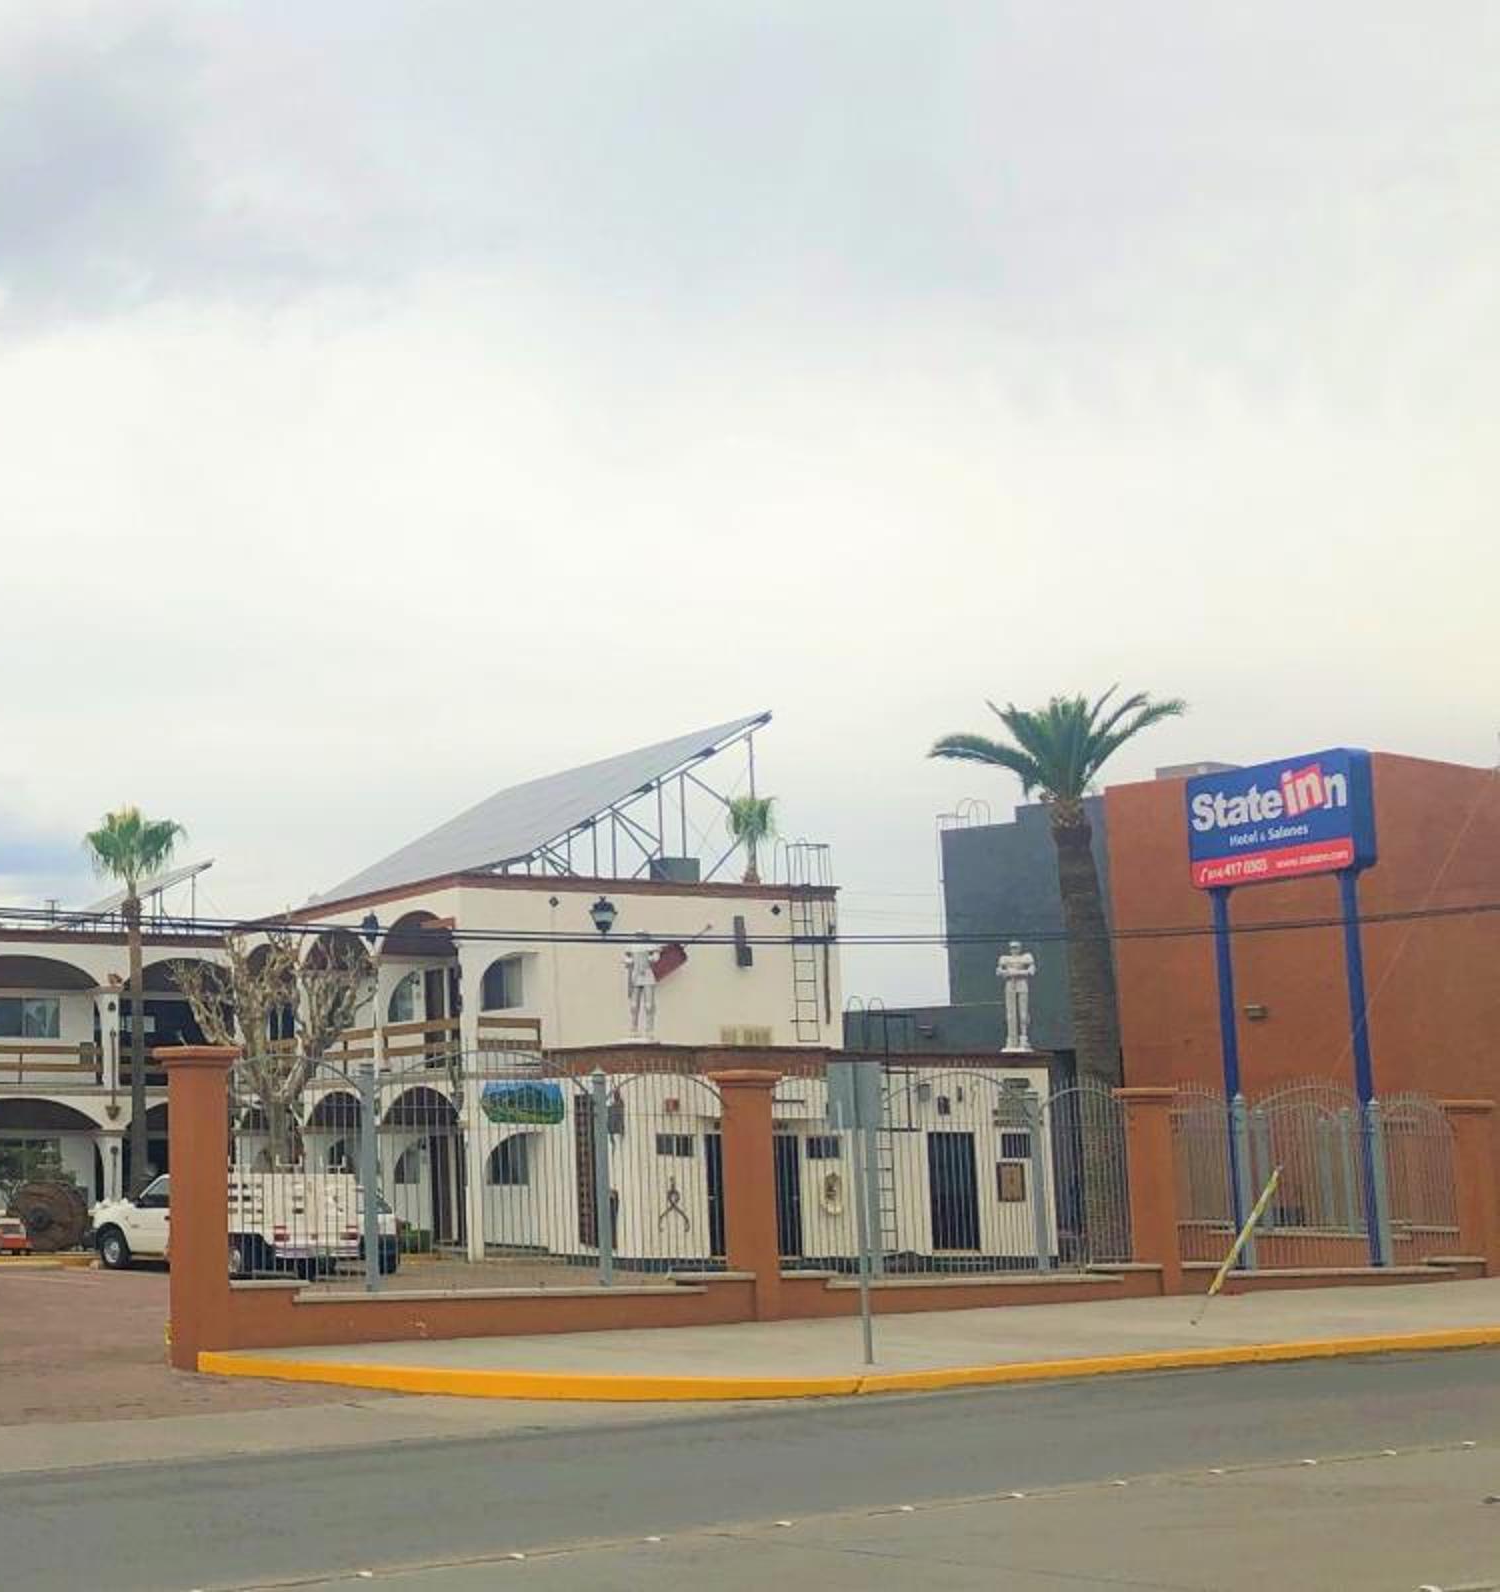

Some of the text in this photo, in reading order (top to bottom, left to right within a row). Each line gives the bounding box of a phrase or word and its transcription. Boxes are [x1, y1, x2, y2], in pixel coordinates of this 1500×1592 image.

[1229, 829, 1258, 848] Hotel
[1267, 824, 1309, 841] Salones
[1223, 861, 1242, 878] 417
